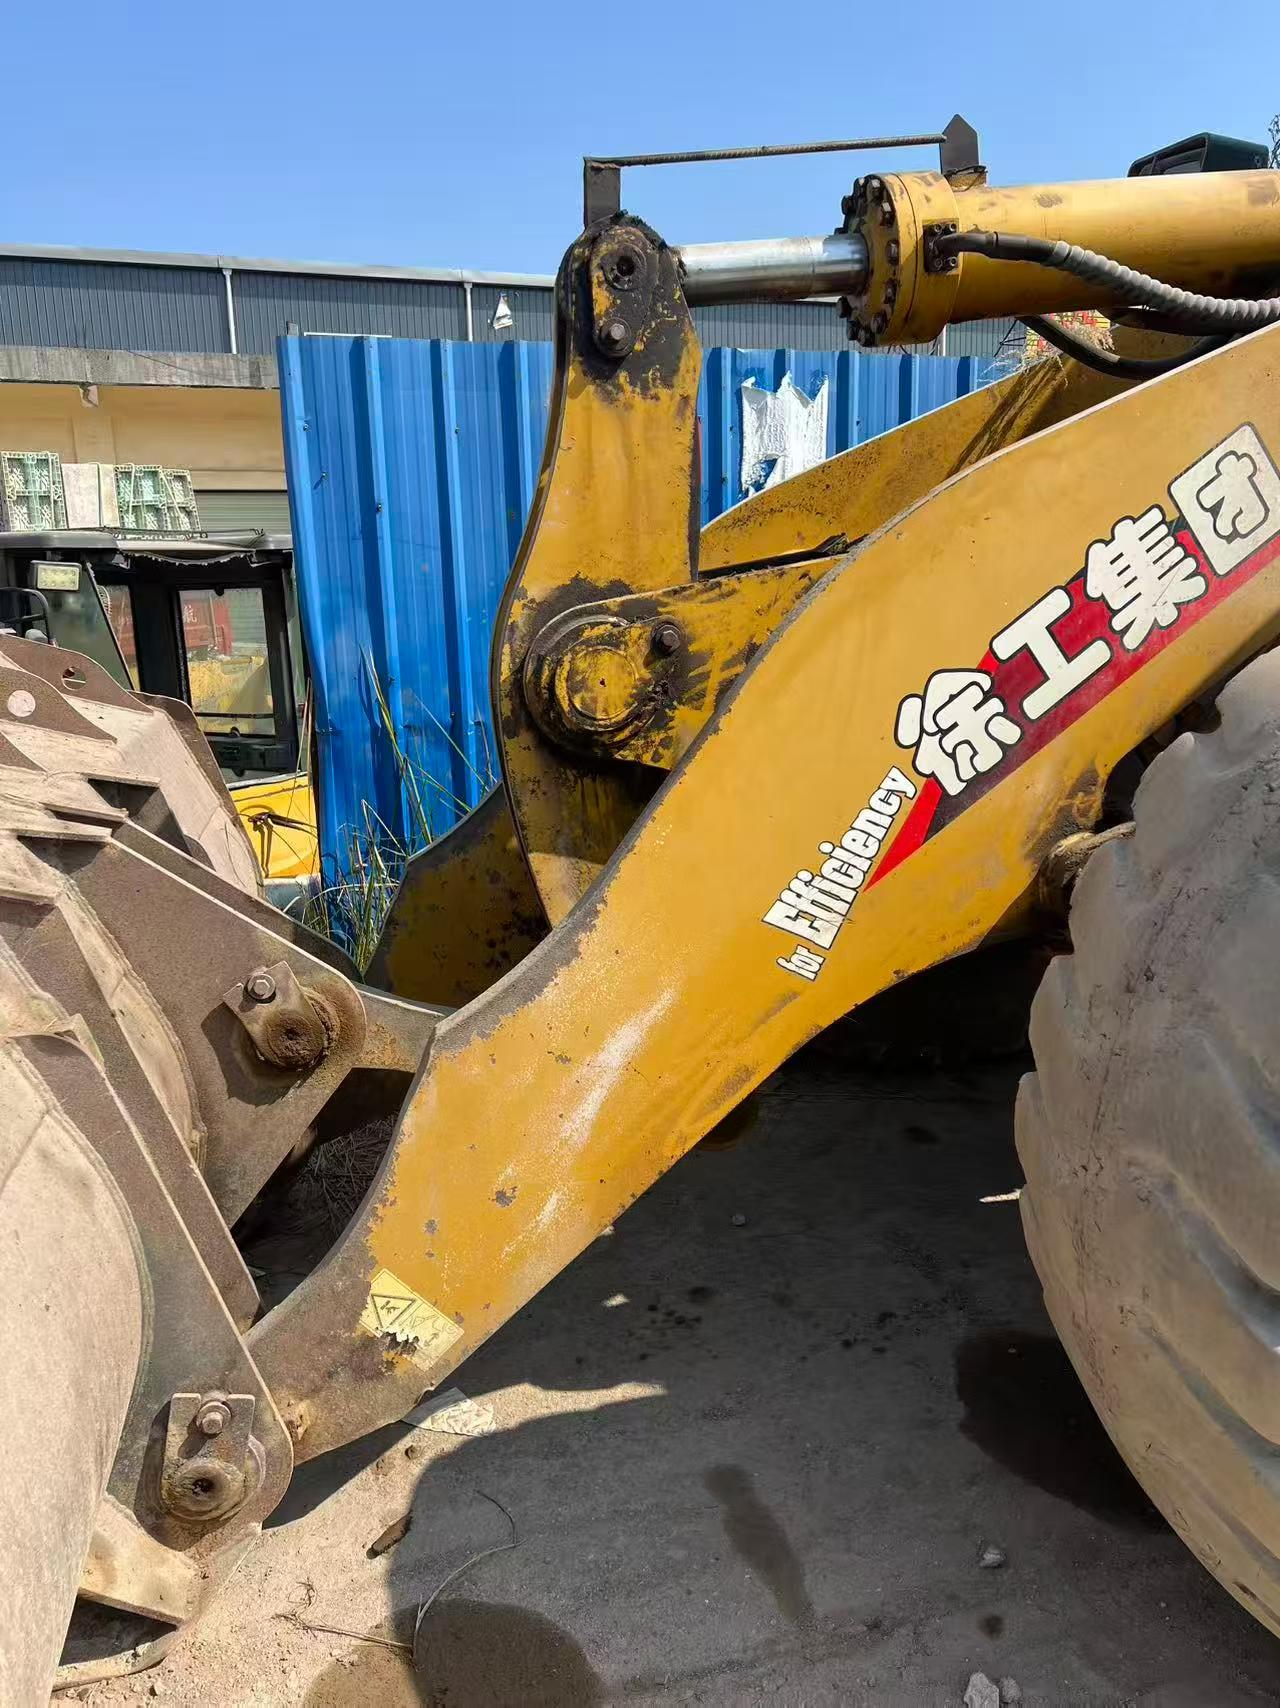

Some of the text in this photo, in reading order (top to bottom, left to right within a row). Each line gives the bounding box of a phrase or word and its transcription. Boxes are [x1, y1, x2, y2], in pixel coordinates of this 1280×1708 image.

[894, 421, 1280, 797] 徐工集团
[762, 765, 917, 982] for Efficiency
